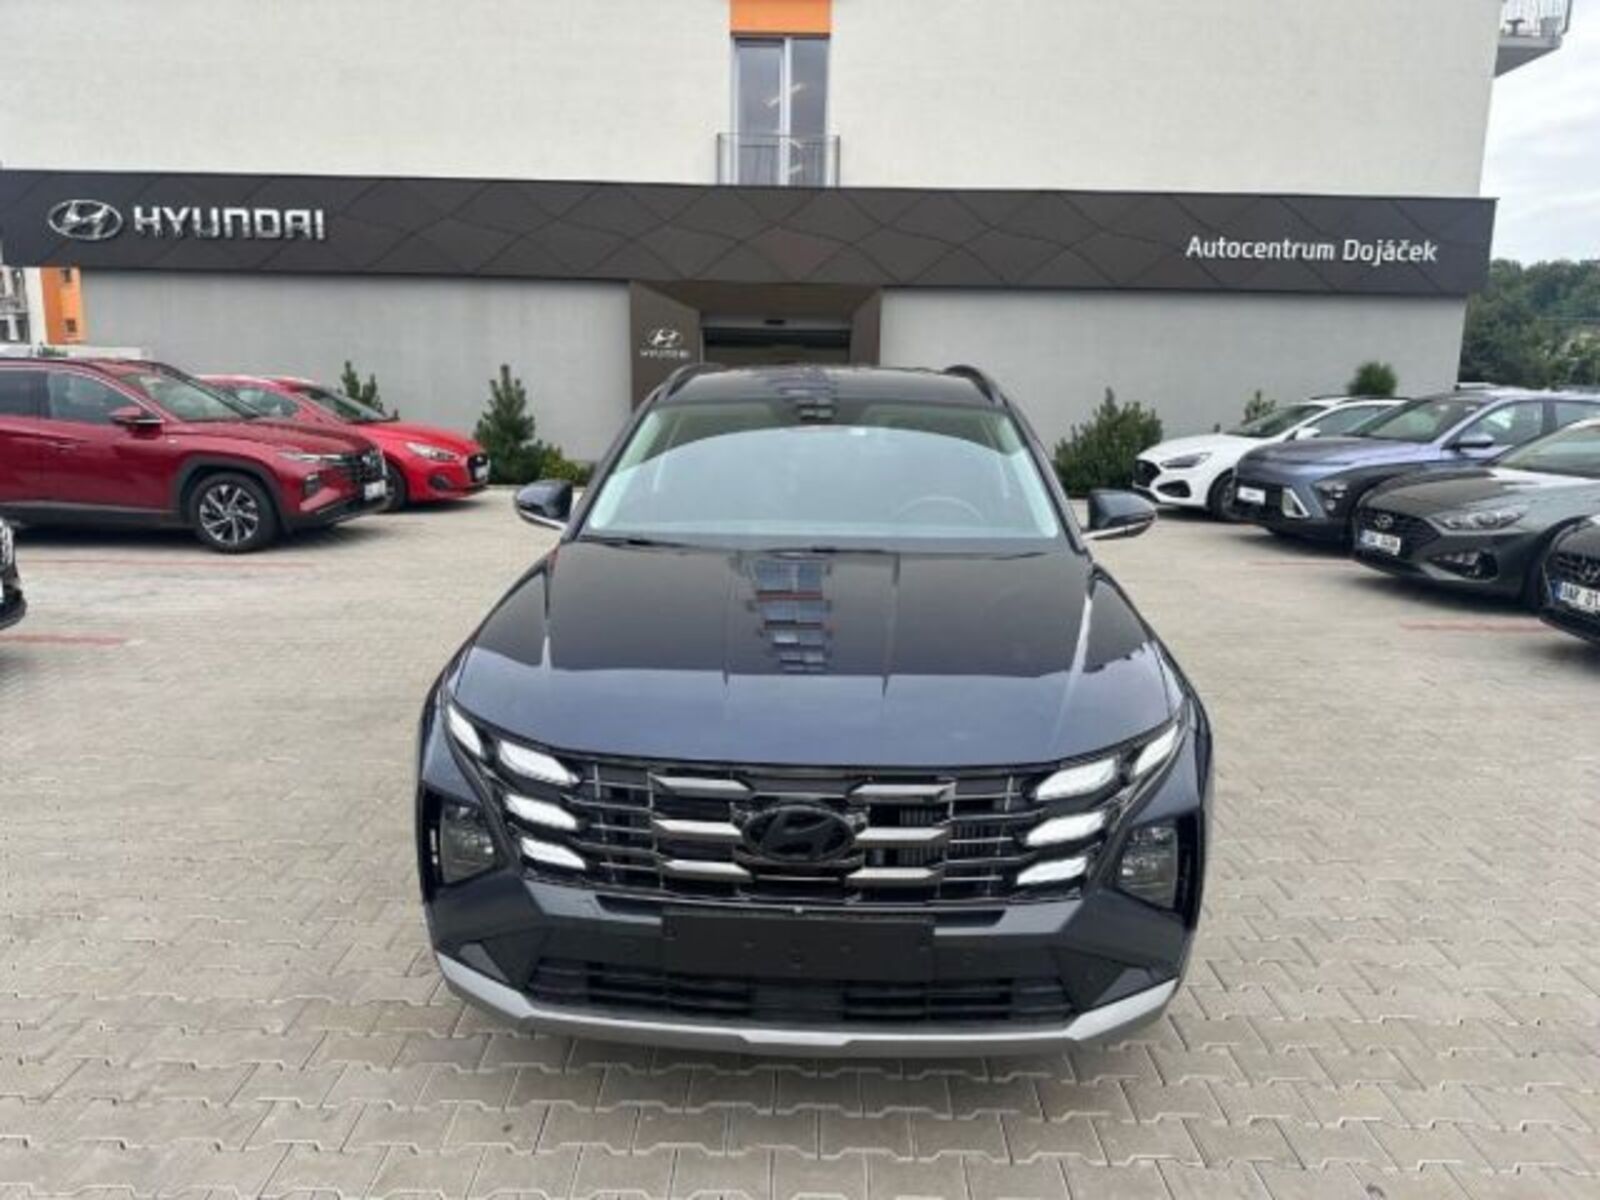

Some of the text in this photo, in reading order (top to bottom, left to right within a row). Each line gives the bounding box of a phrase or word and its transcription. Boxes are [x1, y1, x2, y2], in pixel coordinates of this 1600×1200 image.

[133, 206, 325, 240] HYUNDAI
[1186, 235, 1438, 266] Autocentrum Dojáček
